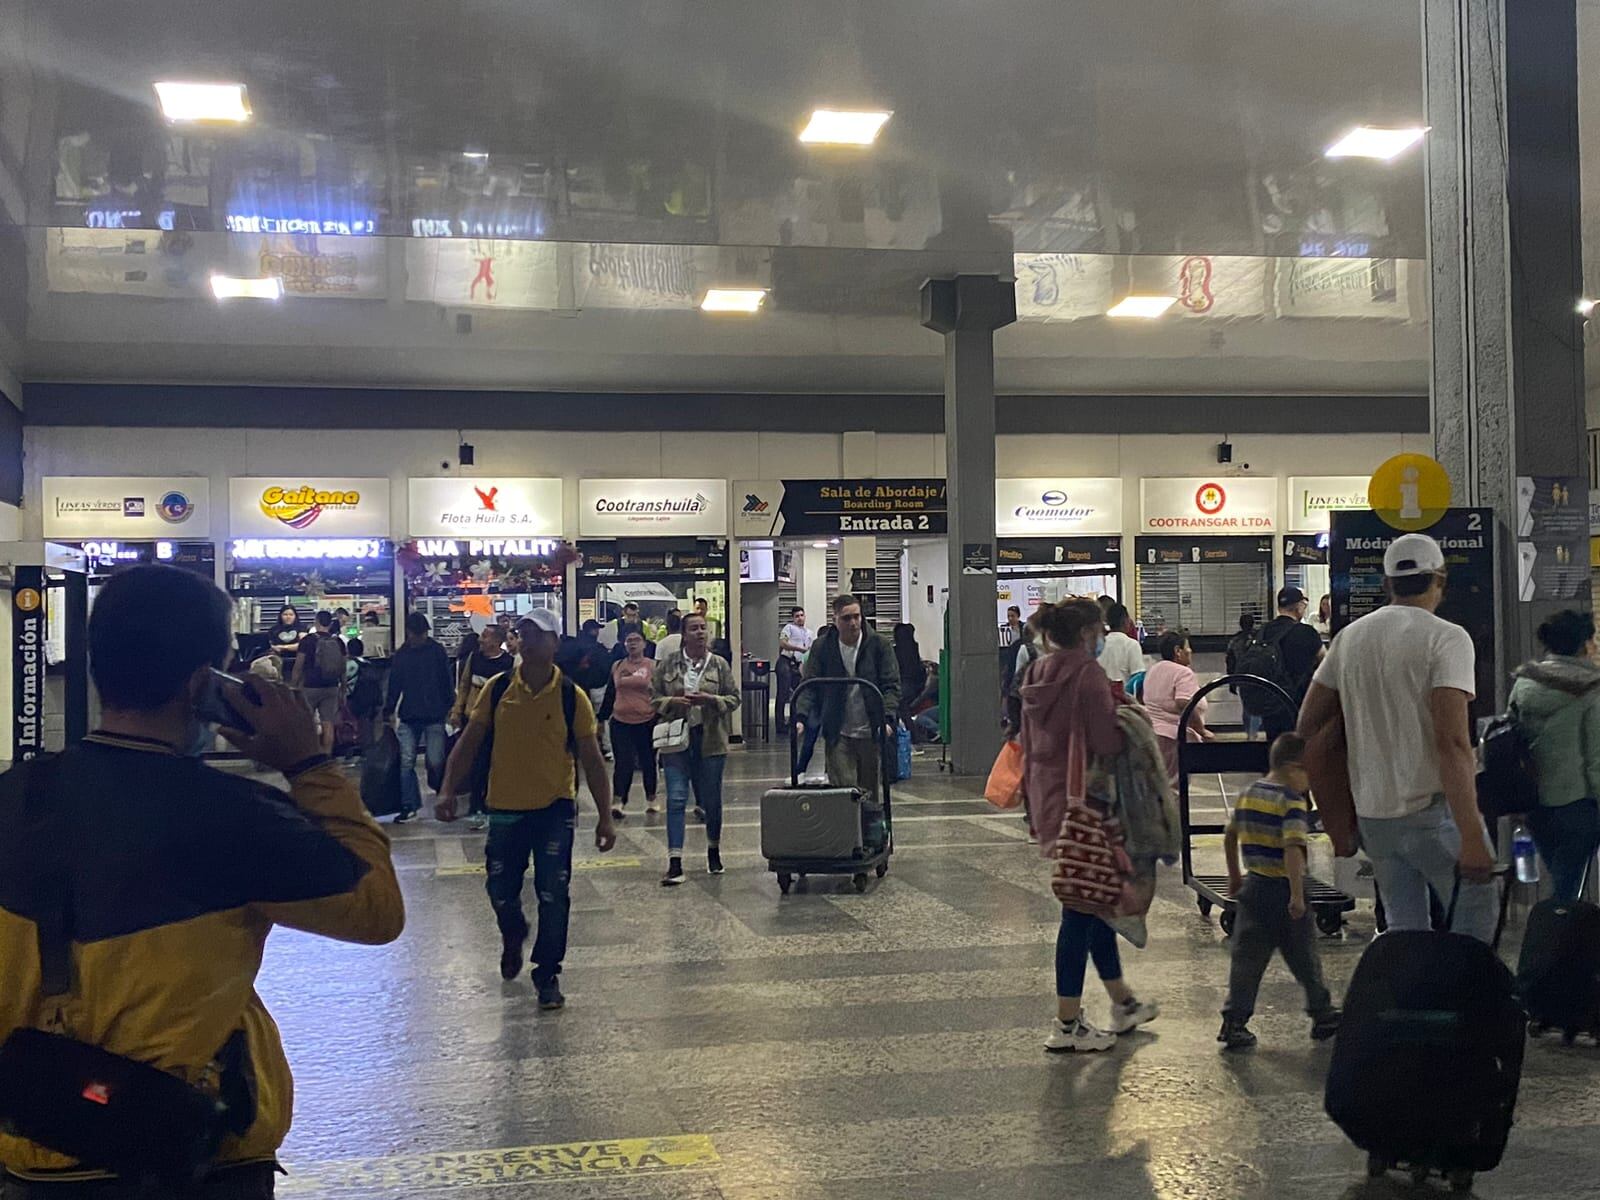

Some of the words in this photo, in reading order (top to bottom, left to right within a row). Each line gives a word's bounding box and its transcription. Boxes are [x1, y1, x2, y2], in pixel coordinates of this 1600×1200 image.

[263, 485, 360, 504] Gaitana
[820, 486, 851, 498] Sala
[854, 486, 872, 498] de
[875, 486, 937, 499] Abordaje
[1349, 492, 1368, 504] VER
[93, 499, 122, 509] VERDES
[596, 498, 700, 513] Cootranshuila
[843, 499, 892, 510] Boarding
[894, 500, 924, 509] Room
[1015, 505, 1094, 518] Coomotor
[441, 513, 471, 524] Flota
[475, 513, 505, 524] Huila
[509, 513, 533, 524] S.A.
[839, 515, 914, 531] Entrada
[918, 515, 929, 530] 2
[1149, 518, 1238, 527] COOTRANSGAR
[1241, 518, 1272, 527] LTDA
[1467, 513, 1482, 531] 2
[1345, 537, 1393, 550] Módu
[1438, 535, 1484, 549] ional
[18, 617, 38, 747] Información
